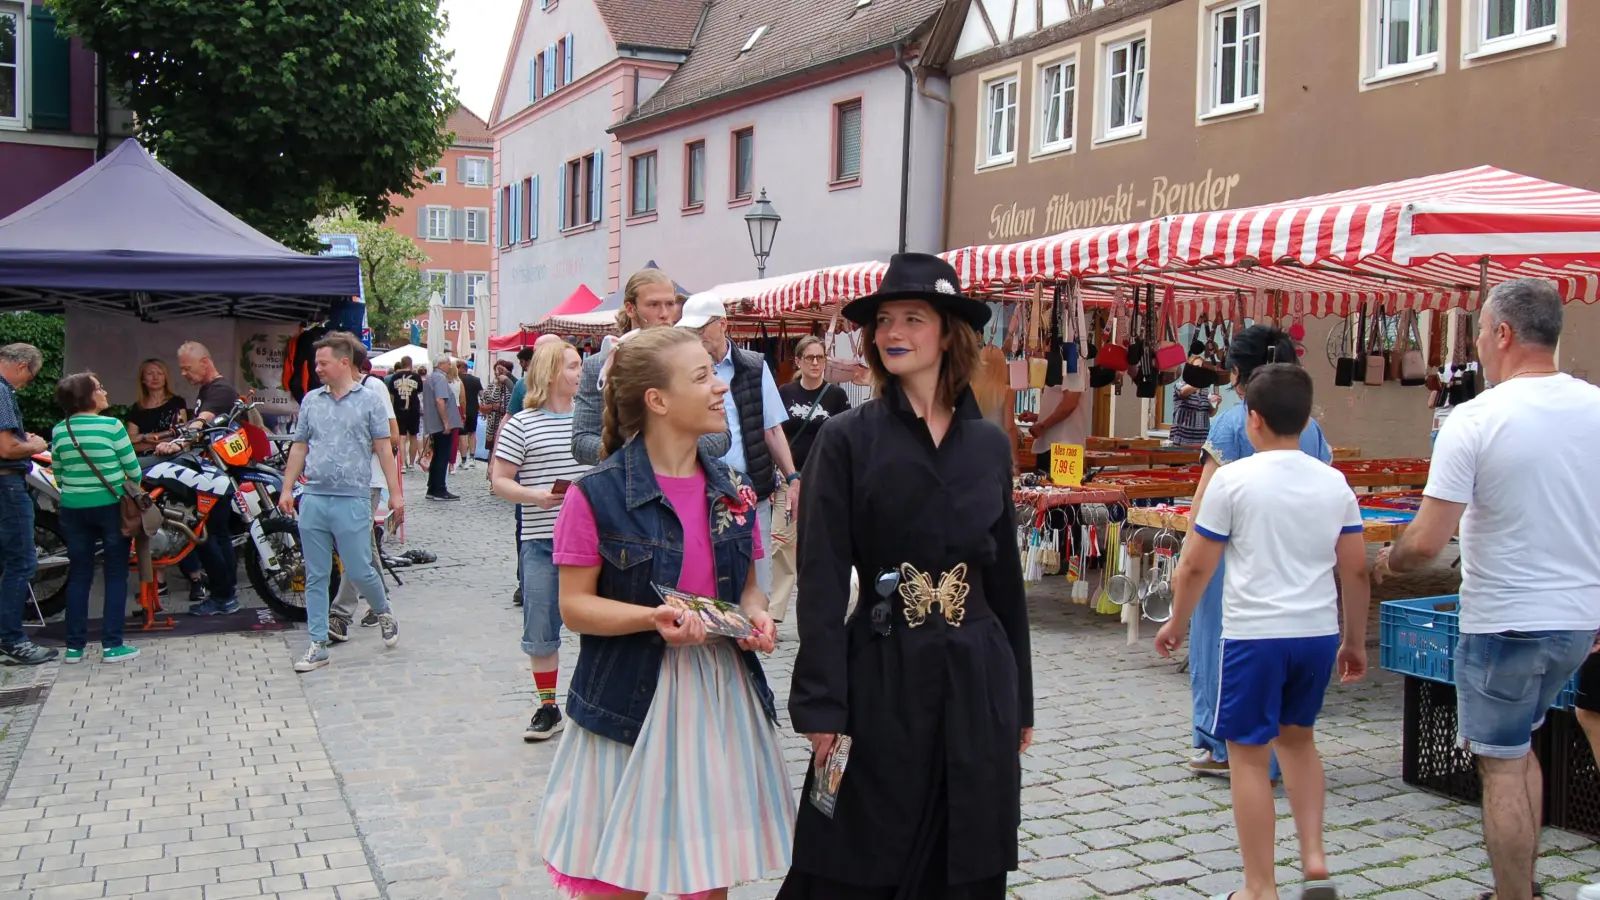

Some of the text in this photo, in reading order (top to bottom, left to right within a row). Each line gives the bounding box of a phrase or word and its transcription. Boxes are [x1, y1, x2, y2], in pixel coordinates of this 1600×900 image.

[988, 201, 1036, 239] Salon
[229, 440, 243, 454] 66
[145, 461, 231, 496] KTM
[1053, 459, 1076, 475] 7,99 €
